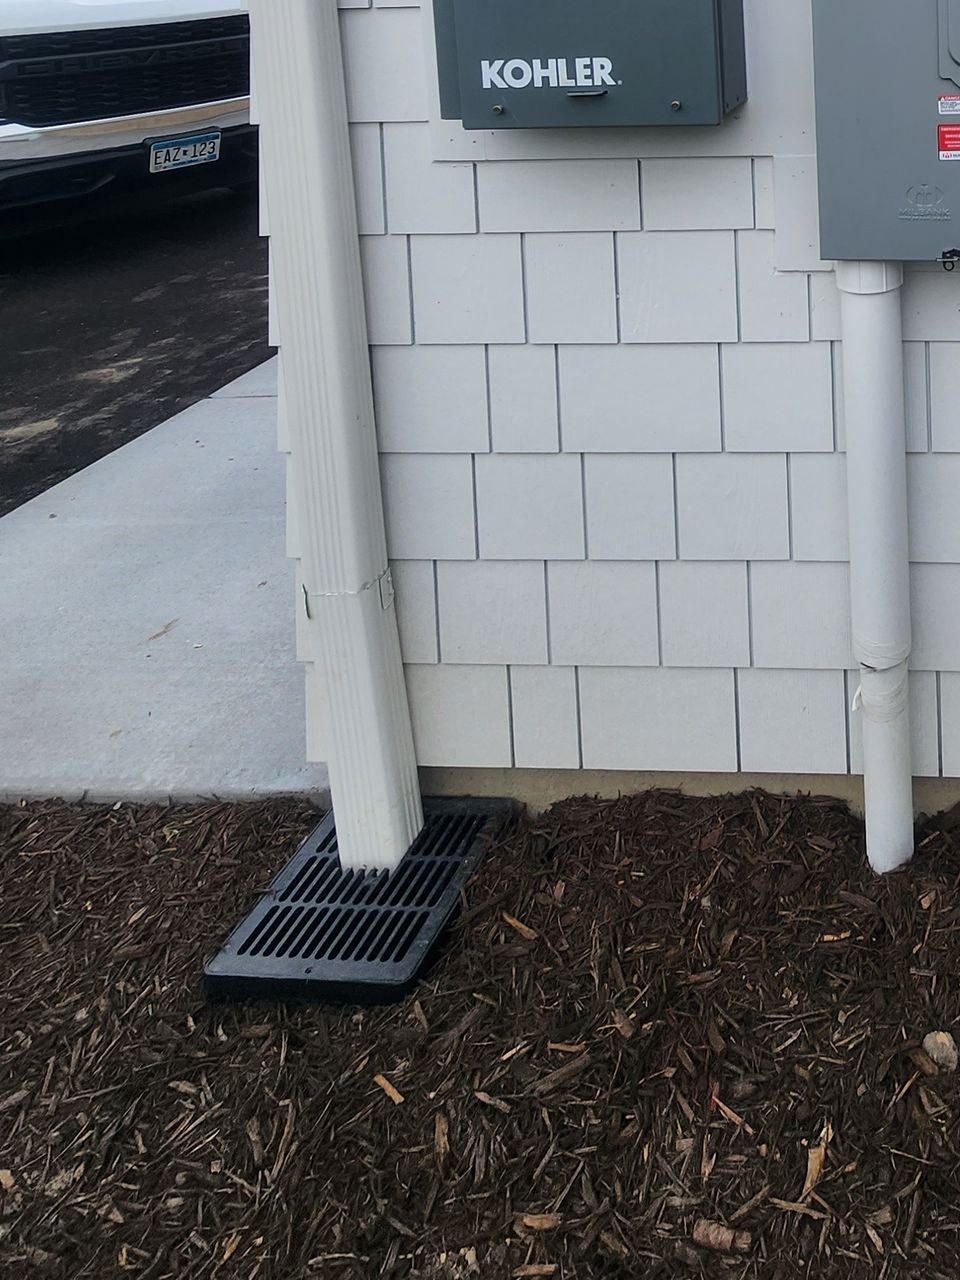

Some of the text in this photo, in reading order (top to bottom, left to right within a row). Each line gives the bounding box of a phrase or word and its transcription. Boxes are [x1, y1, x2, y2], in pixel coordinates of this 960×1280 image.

[481, 57, 616, 89] KOHLER
[155, 147, 181, 165] EAZ
[191, 141, 216, 158] 123
